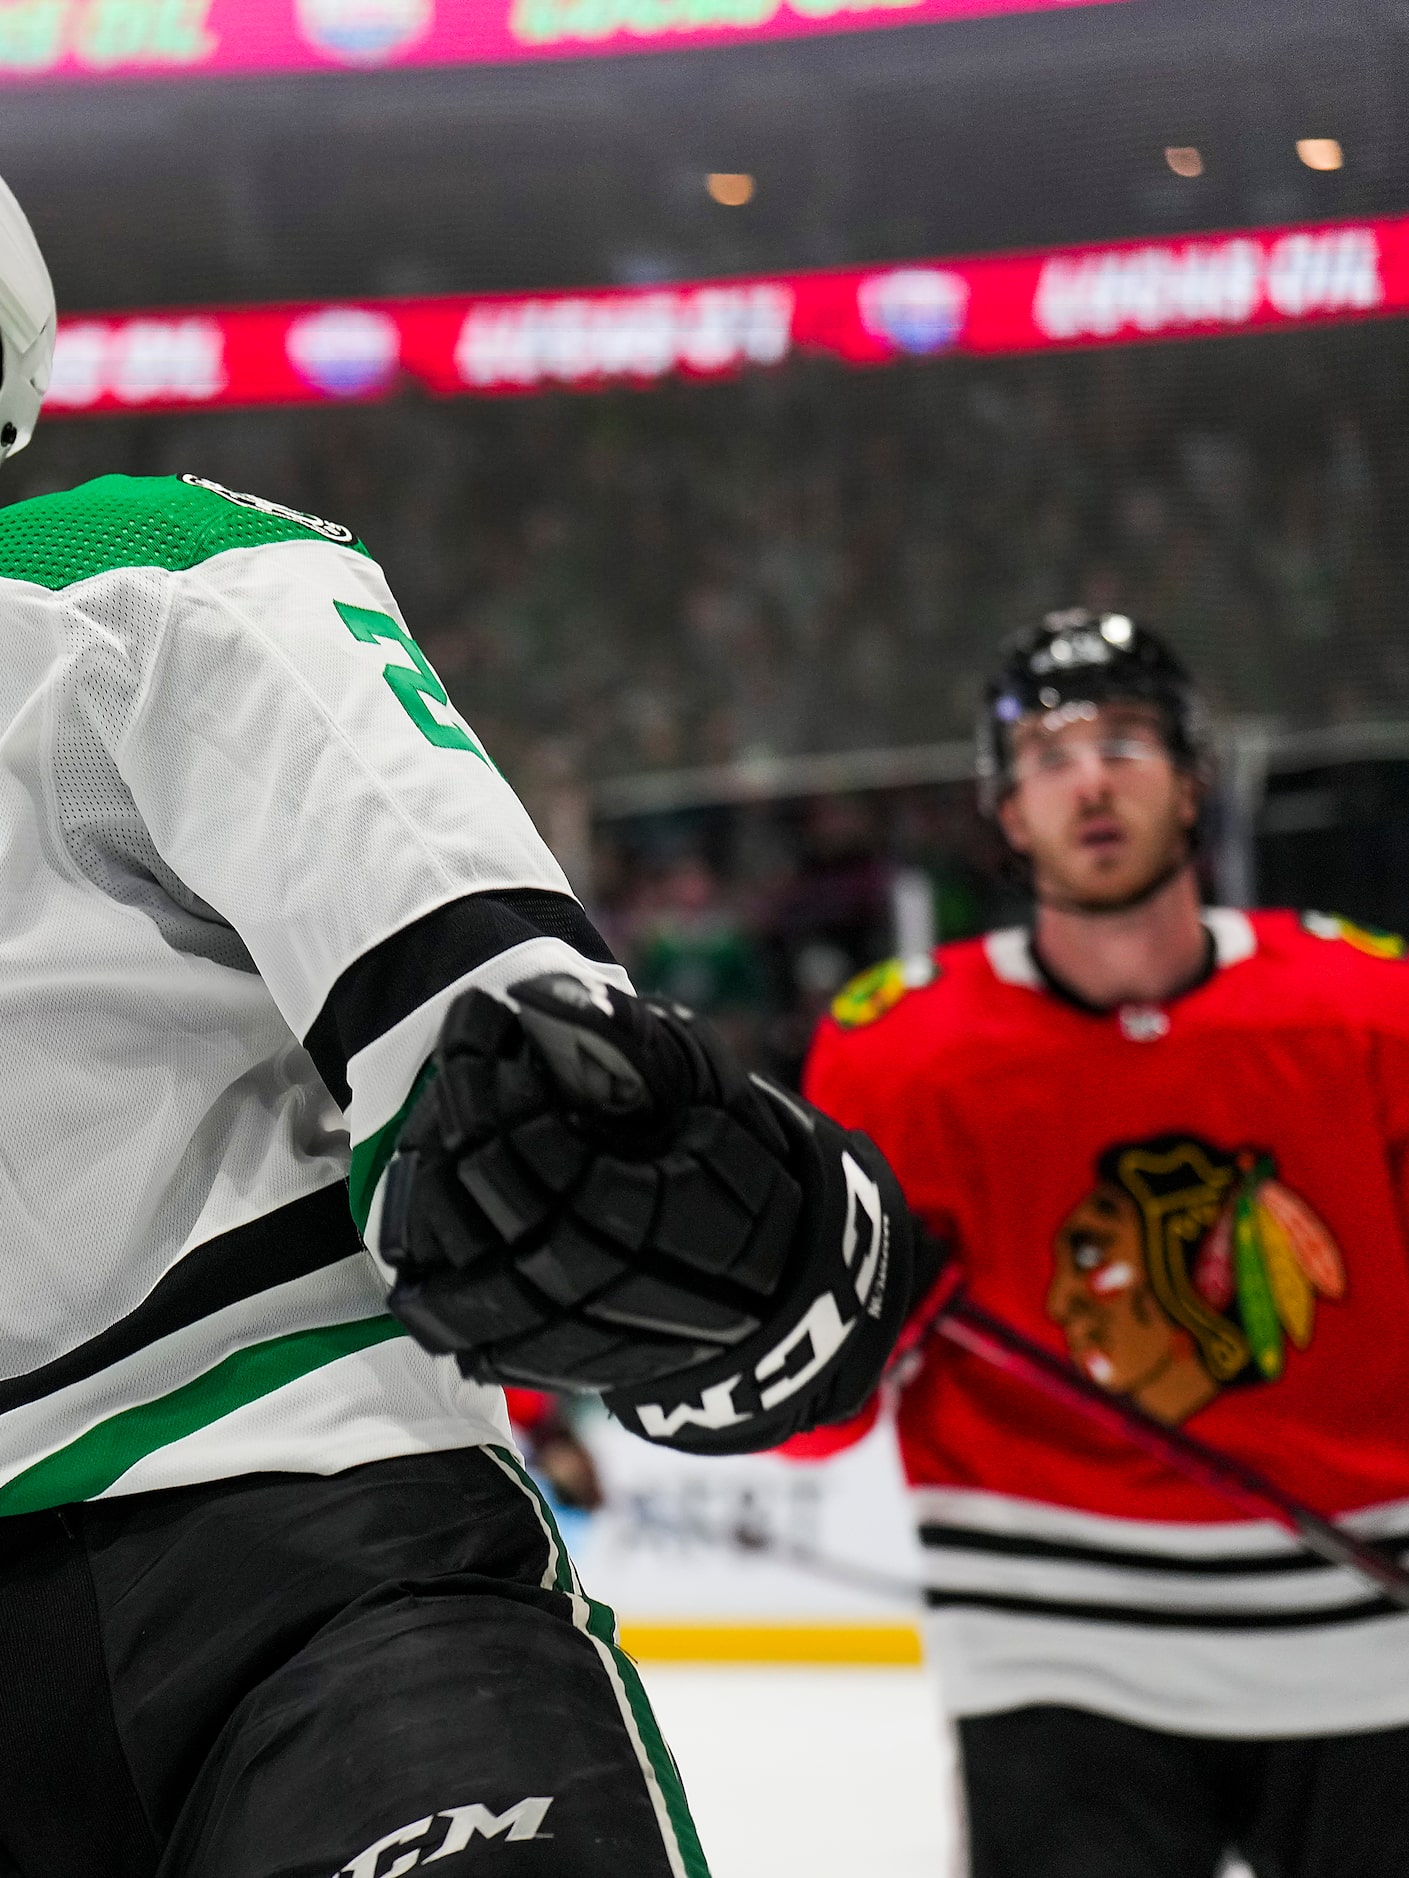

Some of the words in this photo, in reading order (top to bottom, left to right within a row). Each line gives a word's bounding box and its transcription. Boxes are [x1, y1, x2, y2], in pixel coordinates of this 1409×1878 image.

[332, 598, 509, 784] 2
[635, 1150, 883, 1437] CCM
[331, 1796, 554, 1878] CM
